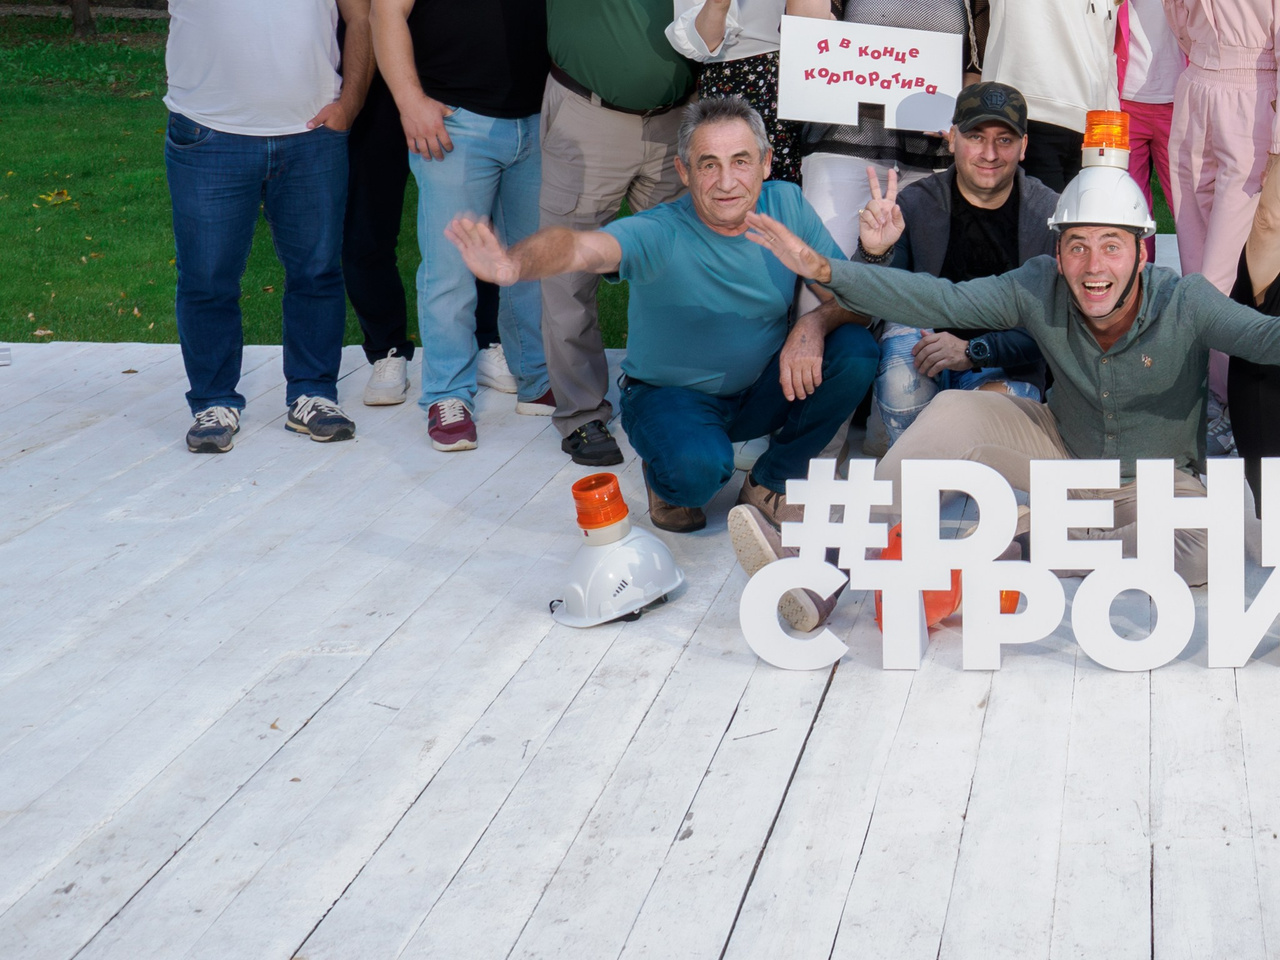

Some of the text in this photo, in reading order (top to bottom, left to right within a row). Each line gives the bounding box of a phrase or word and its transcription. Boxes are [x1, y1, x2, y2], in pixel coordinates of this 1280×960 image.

[816, 39, 830, 55] Я
[858, 45, 920, 64] конце
[804, 67, 938, 95] корпоратива
